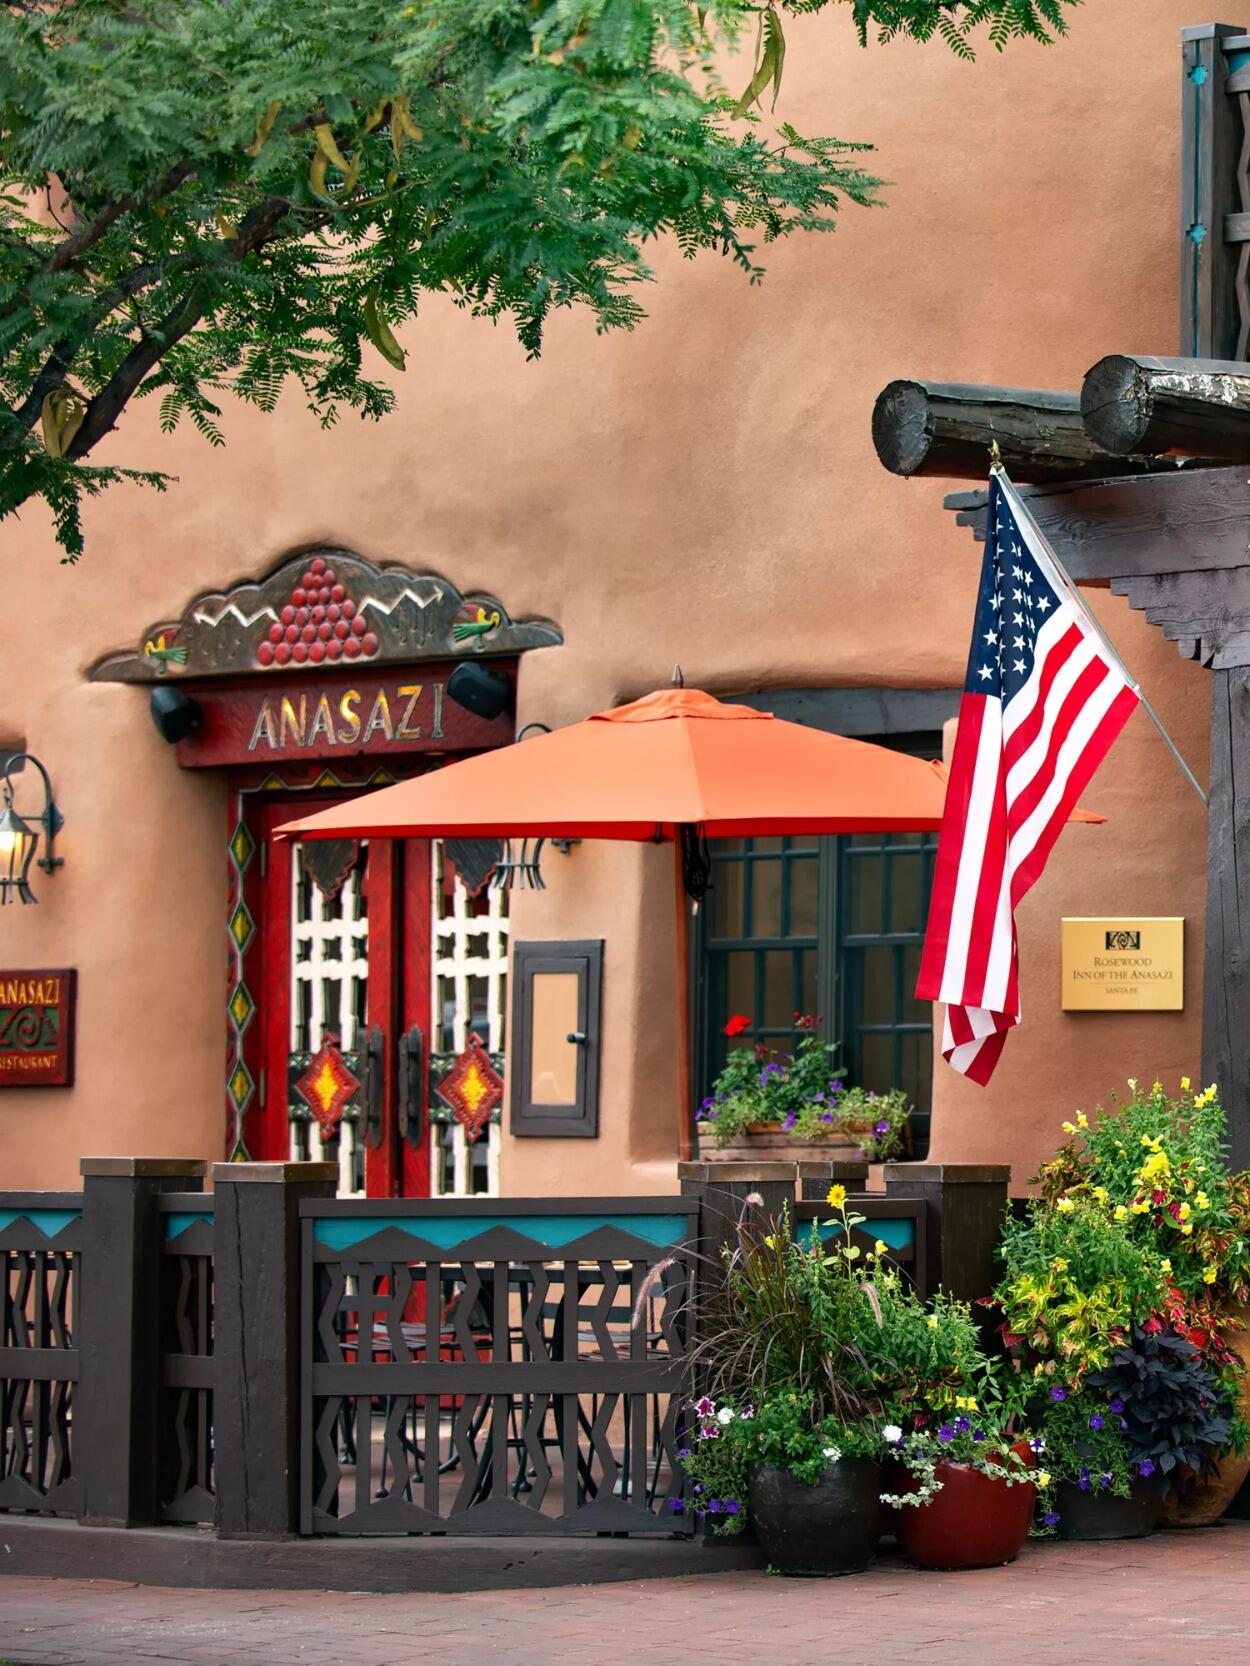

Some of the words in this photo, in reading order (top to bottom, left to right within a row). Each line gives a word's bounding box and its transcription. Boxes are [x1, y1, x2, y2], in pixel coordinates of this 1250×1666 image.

[248, 682, 445, 751] ANASAZI
[1073, 971, 1092, 980] INN
[1093, 971, 1106, 980] OF
[1110, 970, 1128, 980] THE
[1130, 970, 1173, 980] ANASAZI
[0, 979, 60, 1005] ANASAZI
